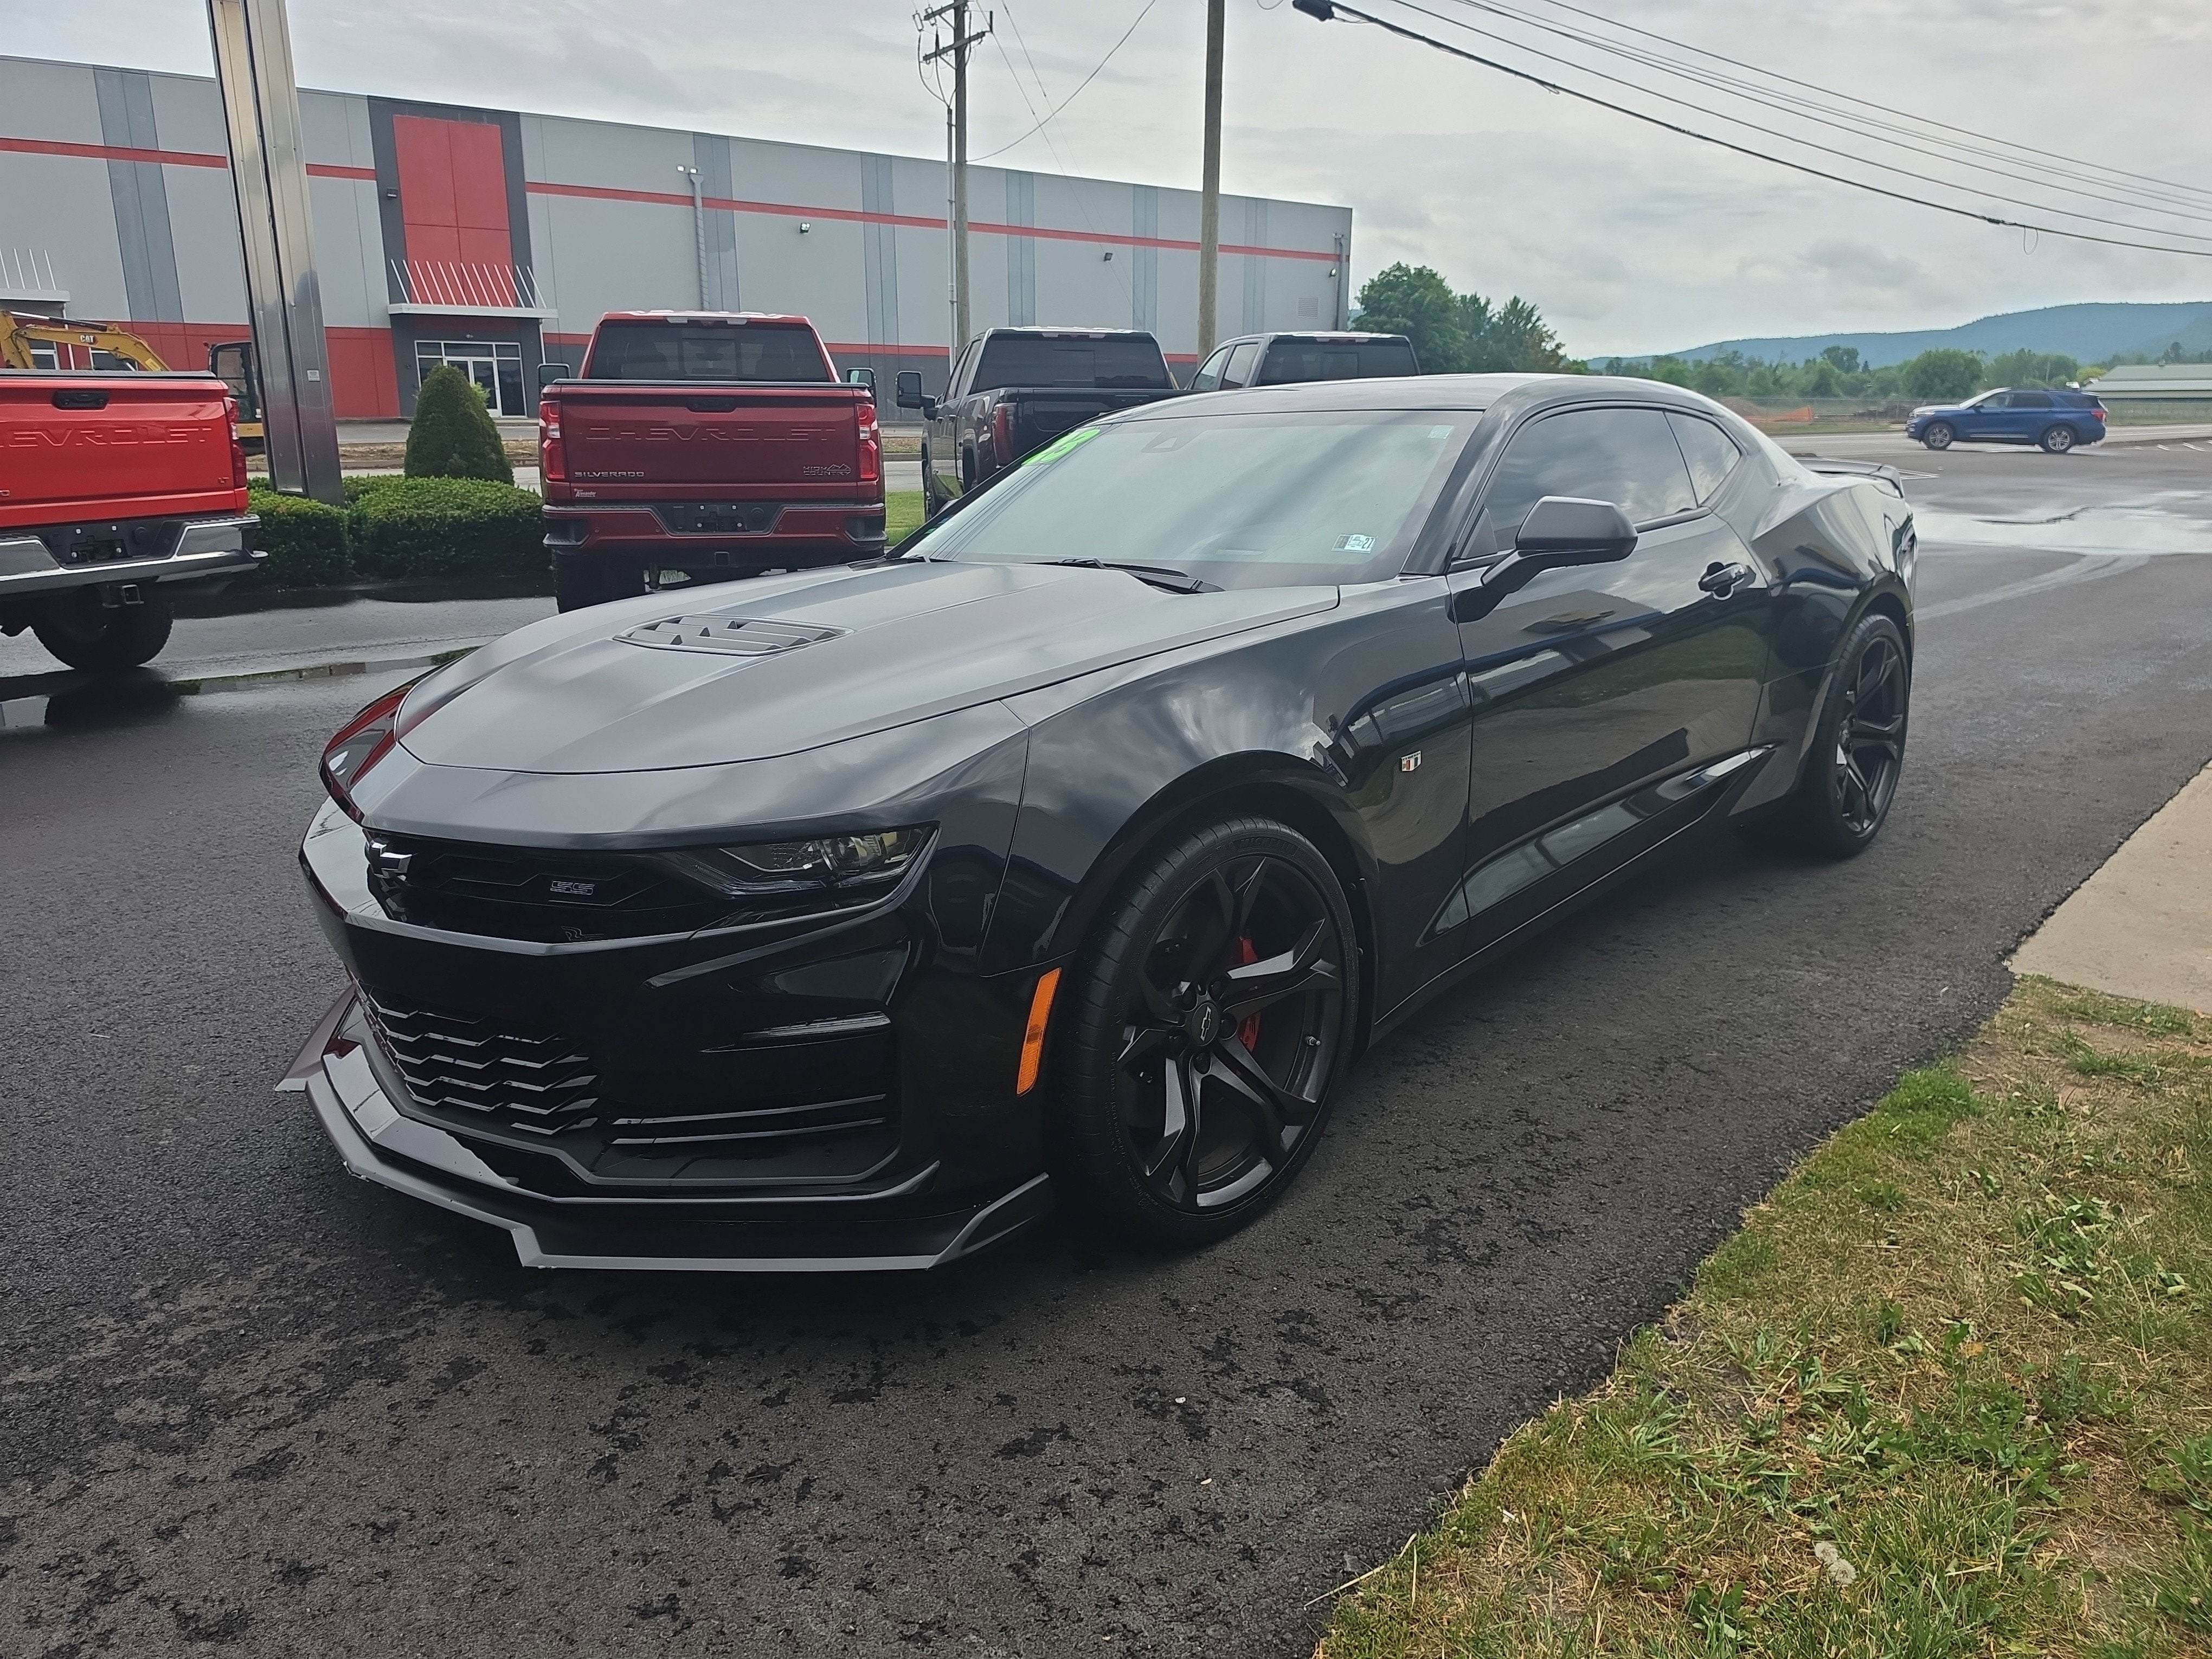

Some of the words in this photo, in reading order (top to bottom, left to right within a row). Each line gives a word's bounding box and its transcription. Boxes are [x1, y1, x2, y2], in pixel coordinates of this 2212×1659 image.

[80, 335, 94, 343] CAT
[0, 426, 213, 448] EVROLET
[586, 426, 836, 441] CHEVROLET
[1361, 537, 1374, 550] 27
[550, 880, 595, 895] SS
